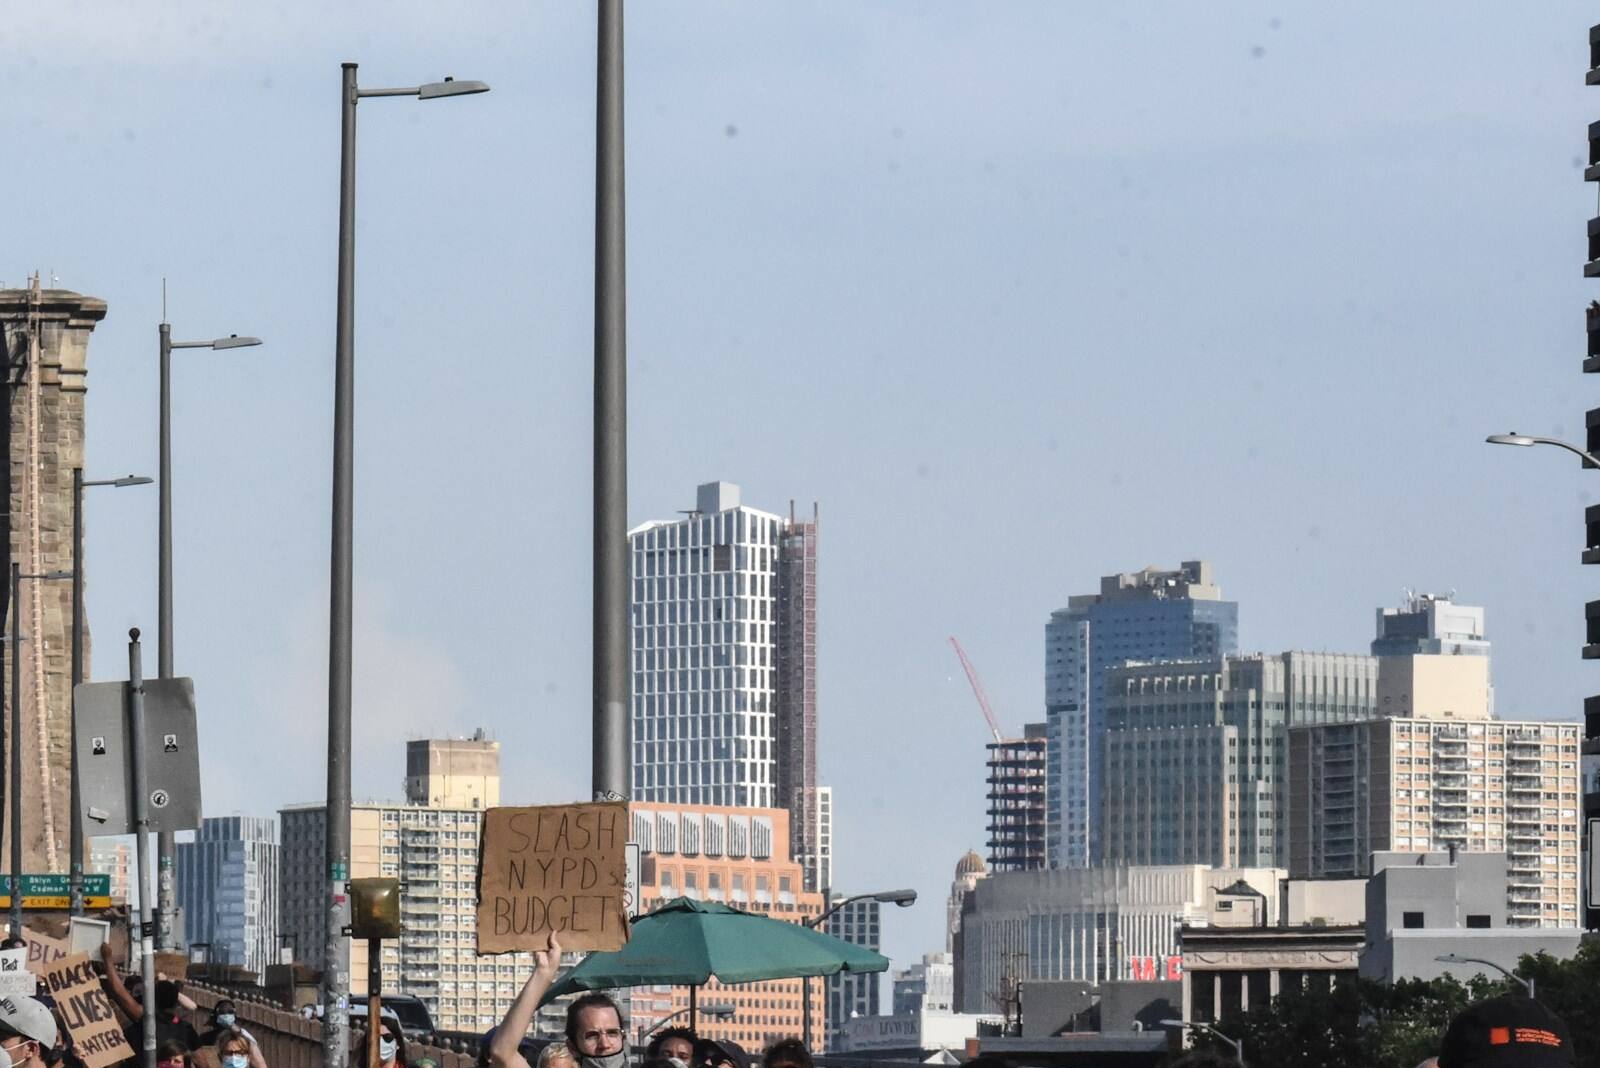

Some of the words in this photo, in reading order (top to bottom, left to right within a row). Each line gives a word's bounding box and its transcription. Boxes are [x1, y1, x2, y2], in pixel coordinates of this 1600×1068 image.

[508, 811, 616, 853] SLASH
[509, 855, 619, 891] NYPD's
[494, 894, 615, 936] BUDGET
[49, 960, 96, 992] BLACK
[59, 989, 113, 1030] LIVES
